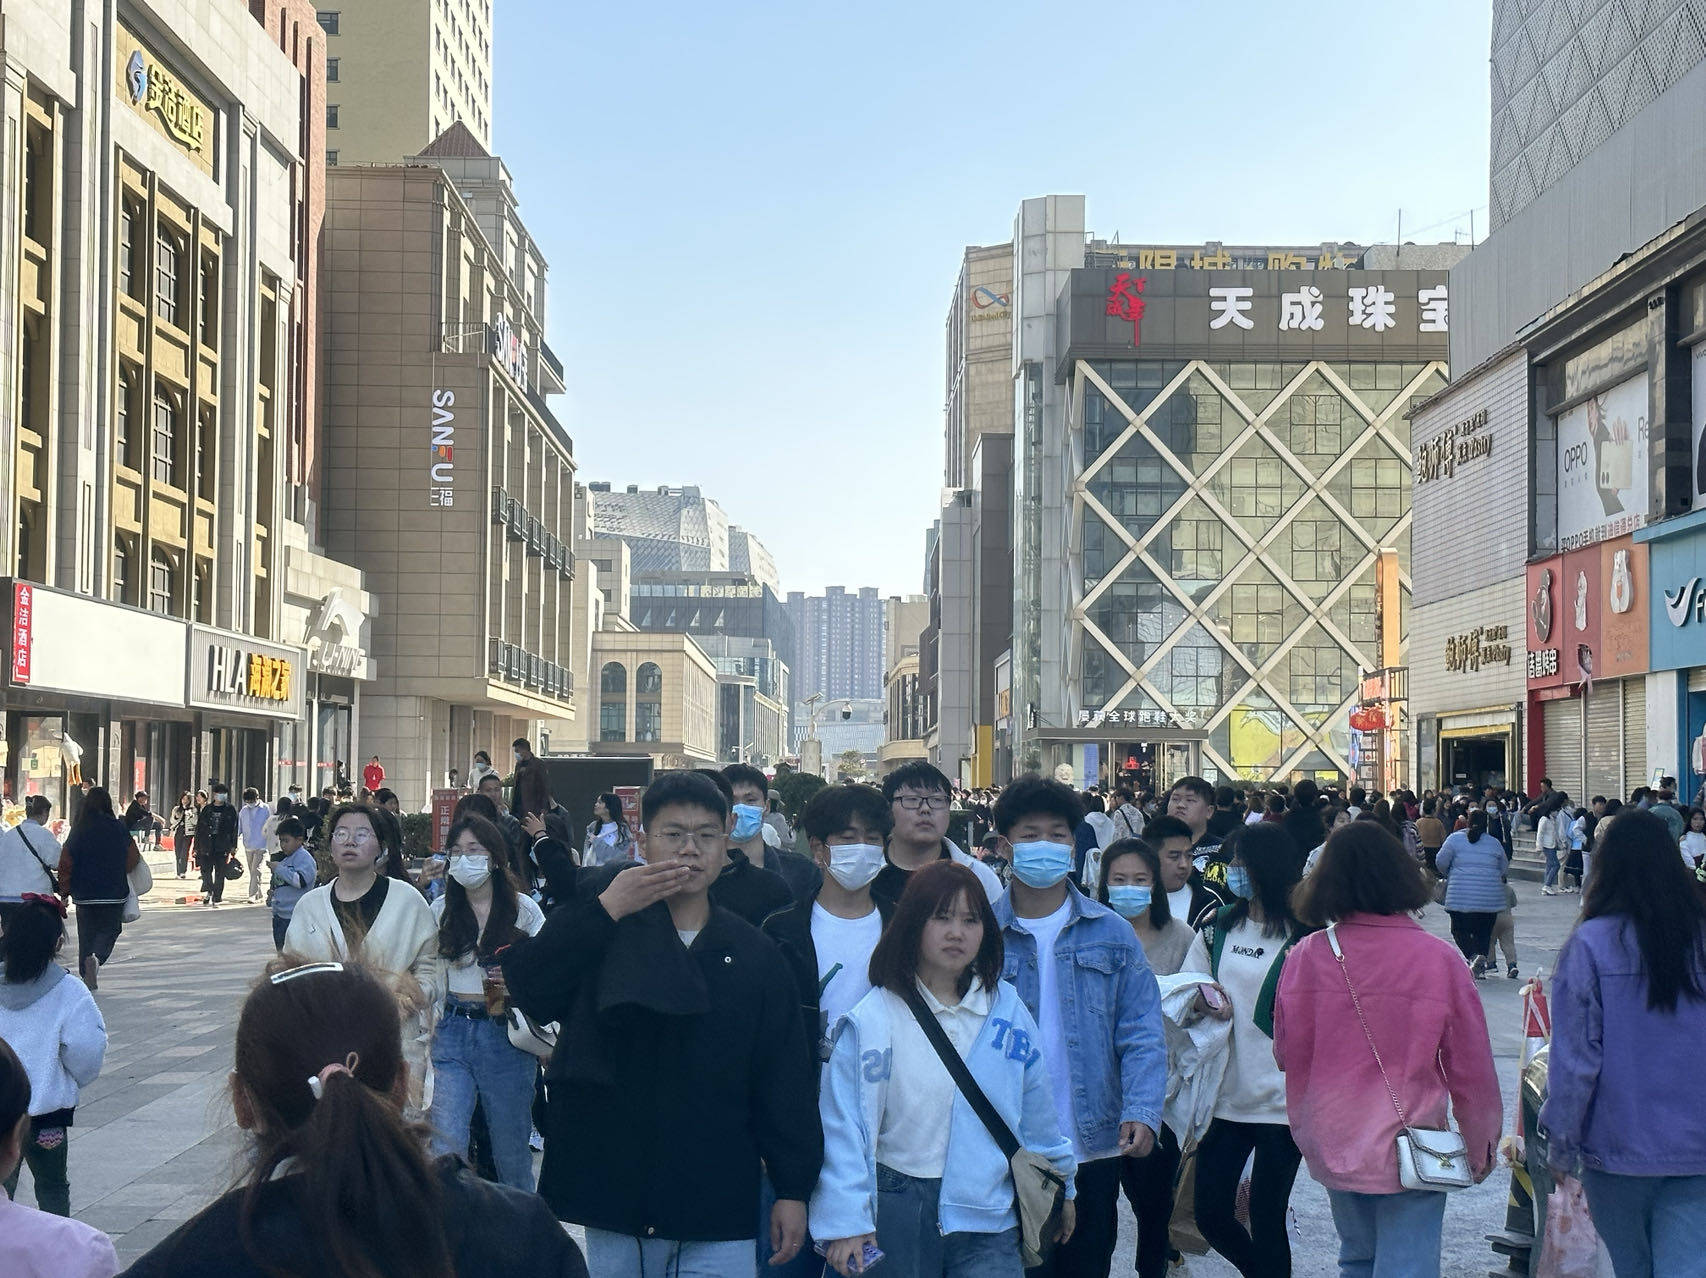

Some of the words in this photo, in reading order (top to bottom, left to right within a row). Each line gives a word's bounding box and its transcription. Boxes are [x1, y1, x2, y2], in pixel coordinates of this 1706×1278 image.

[1208, 285, 1449, 332] 天成珠宝
[431, 389, 455, 481] SANFU
[1564, 441, 1588, 473] OPPO
[431, 487, 454, 506] 三福
[18, 586, 30, 668] 金洁酒店
[208, 645, 248, 695] HLA
